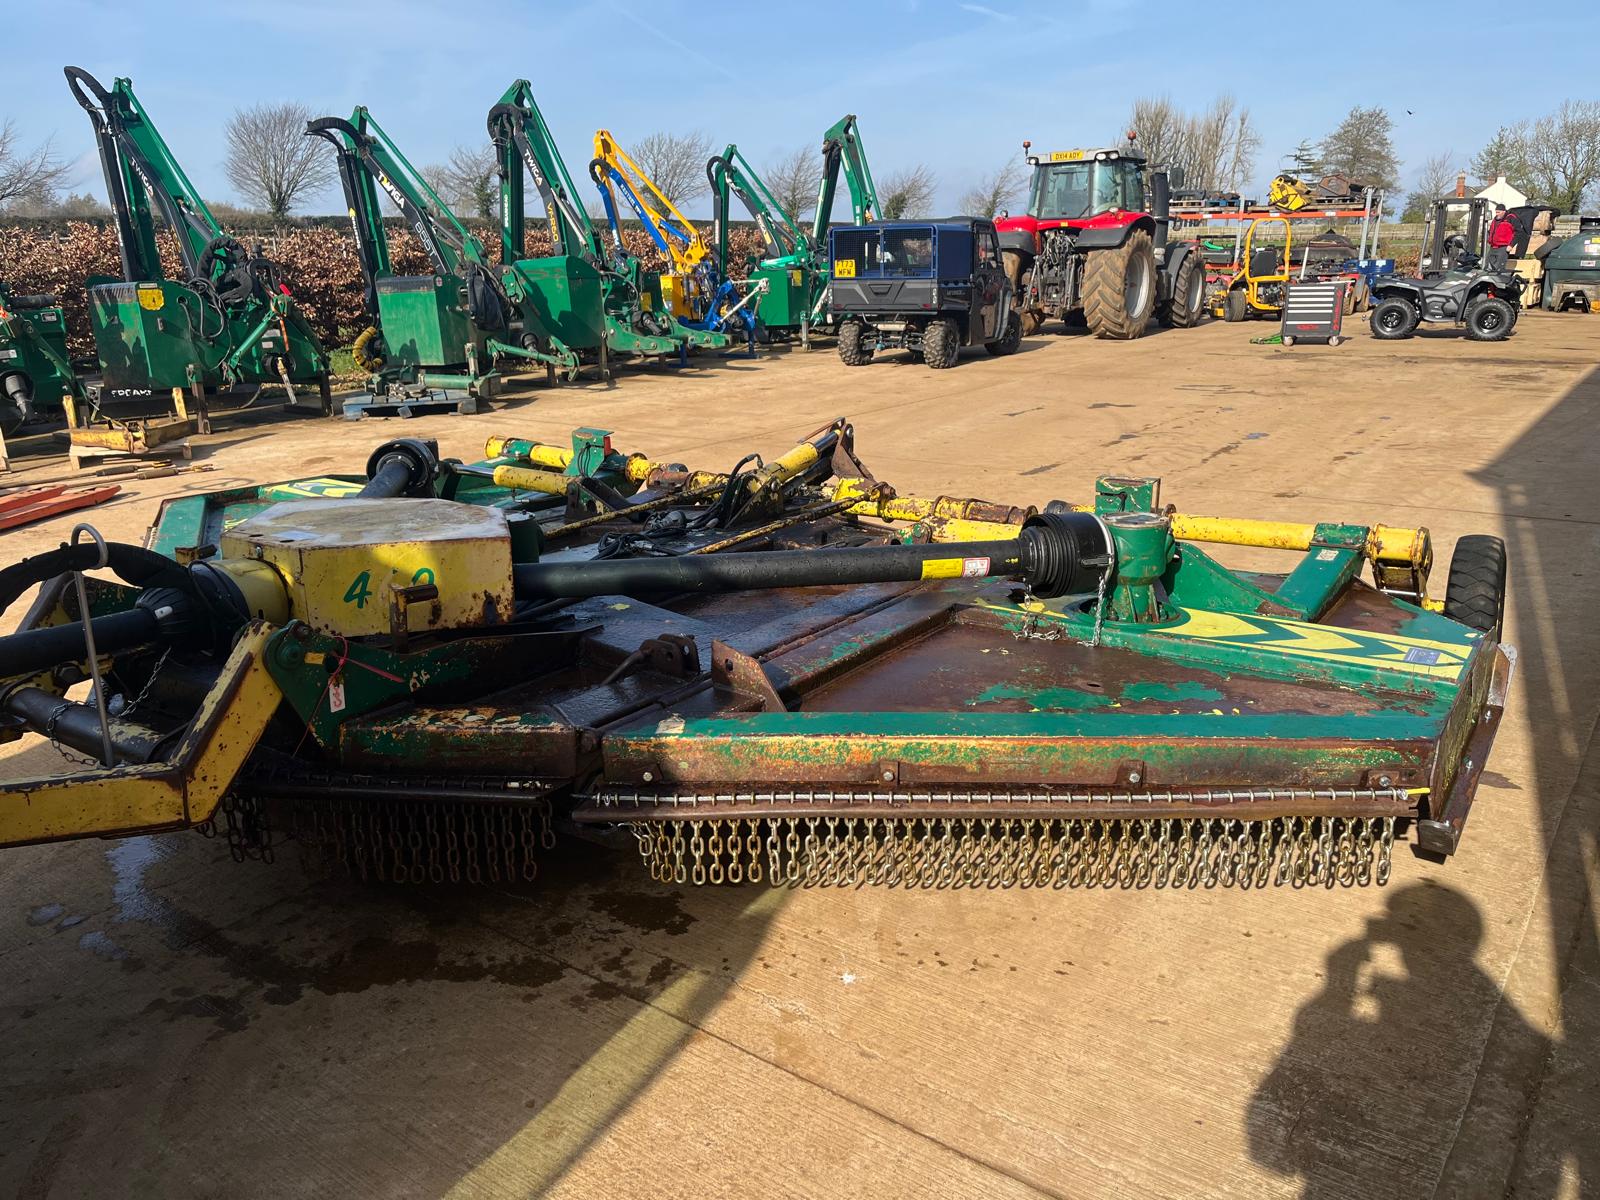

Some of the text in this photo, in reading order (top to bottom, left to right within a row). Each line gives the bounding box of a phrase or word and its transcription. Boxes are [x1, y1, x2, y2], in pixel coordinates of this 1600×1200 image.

[131, 156, 154, 197] TWIGA
[524, 149, 543, 186] TWIGA
[378, 170, 405, 209] TWIGA
